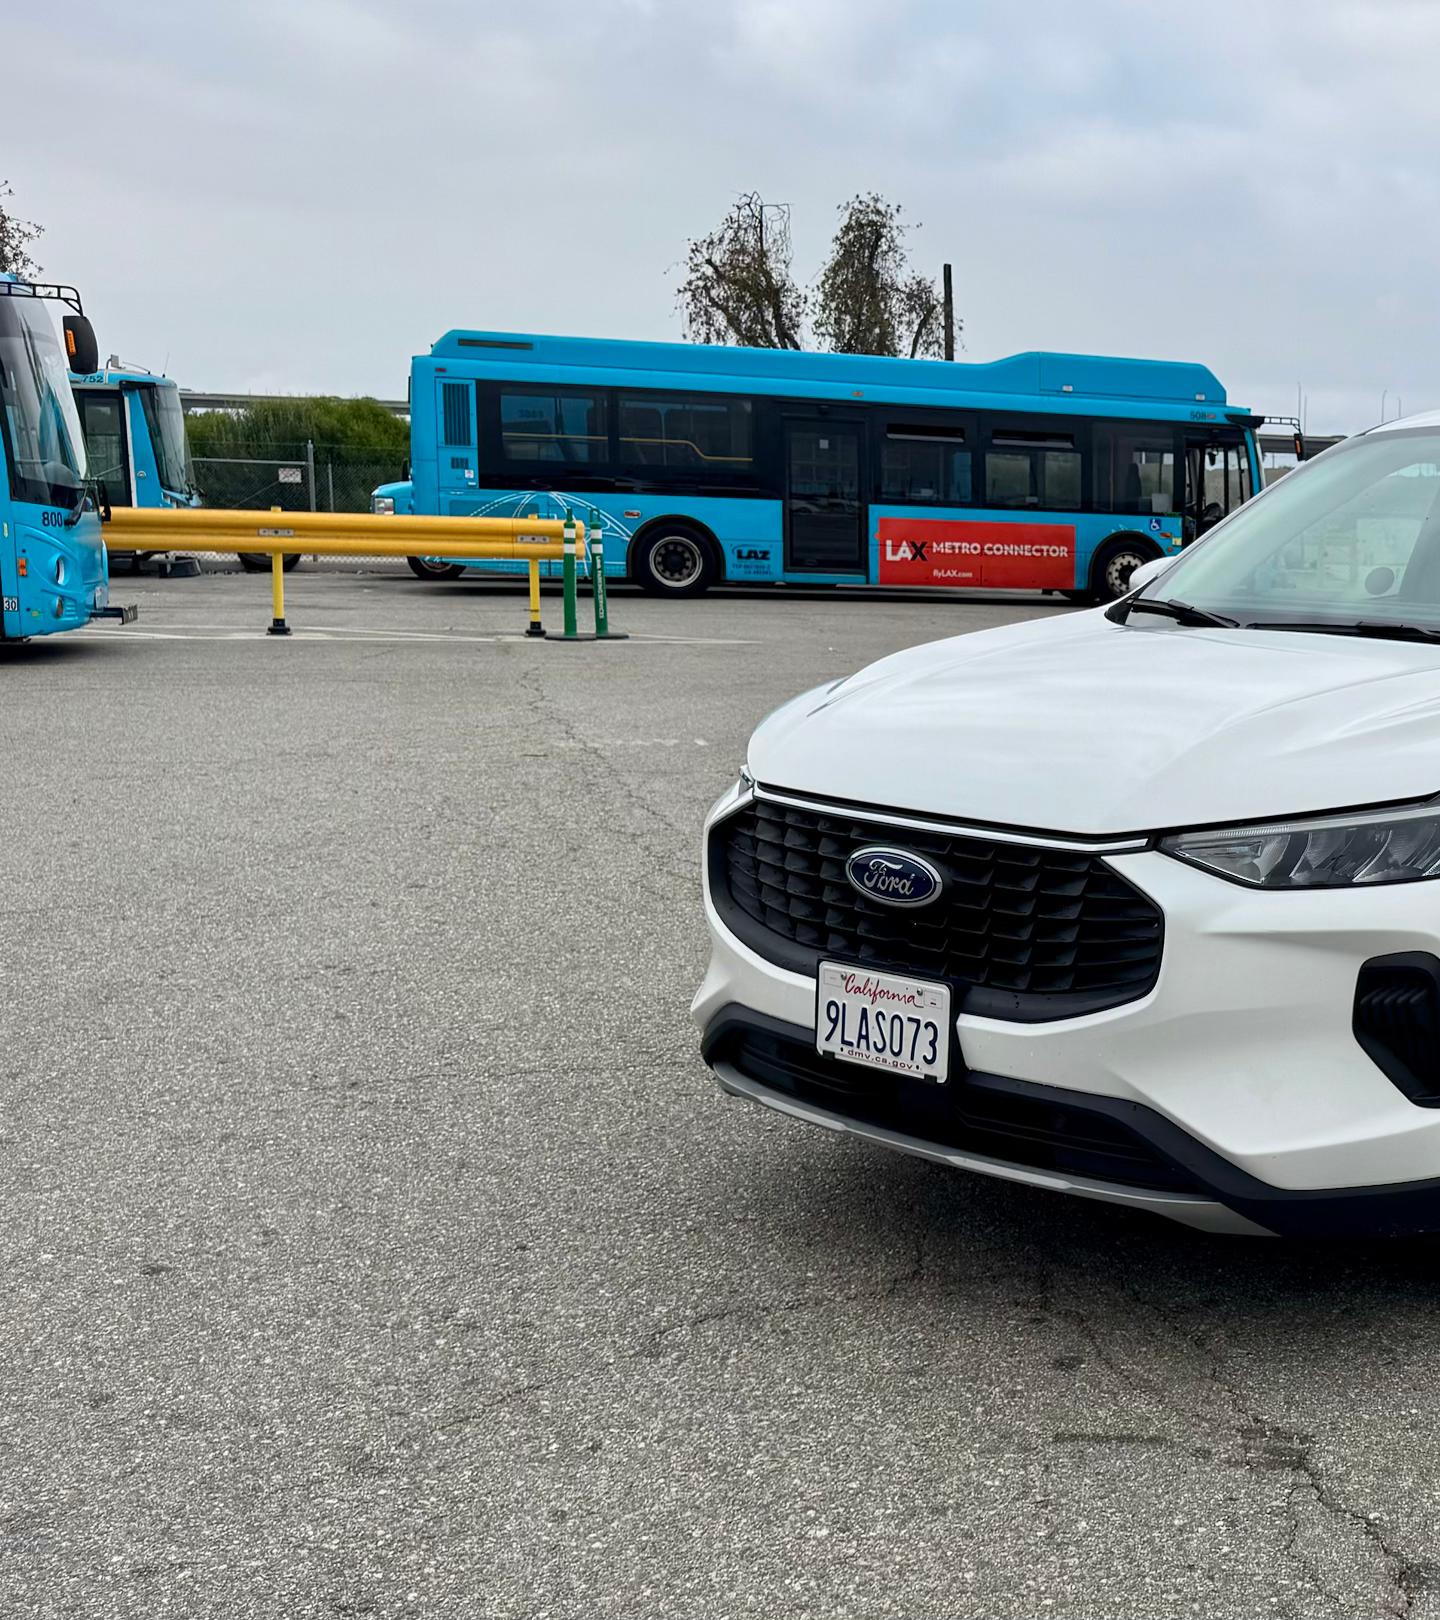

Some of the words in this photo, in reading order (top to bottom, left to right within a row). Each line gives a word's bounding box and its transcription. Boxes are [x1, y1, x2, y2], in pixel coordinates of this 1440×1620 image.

[42, 511, 63, 528] 800
[736, 549, 771, 561] LAZ
[885, 539, 928, 562] LAX
[932, 541, 981, 555] METRO
[983, 543, 1069, 558] CONNECTOR
[932, 568, 973, 579] flyLAX.com
[864, 858, 916, 895] Ford
[844, 973, 925, 1009] California
[824, 1000, 939, 1065] 9LAS073
[847, 1048, 913, 1070] dmv.ca.gov
